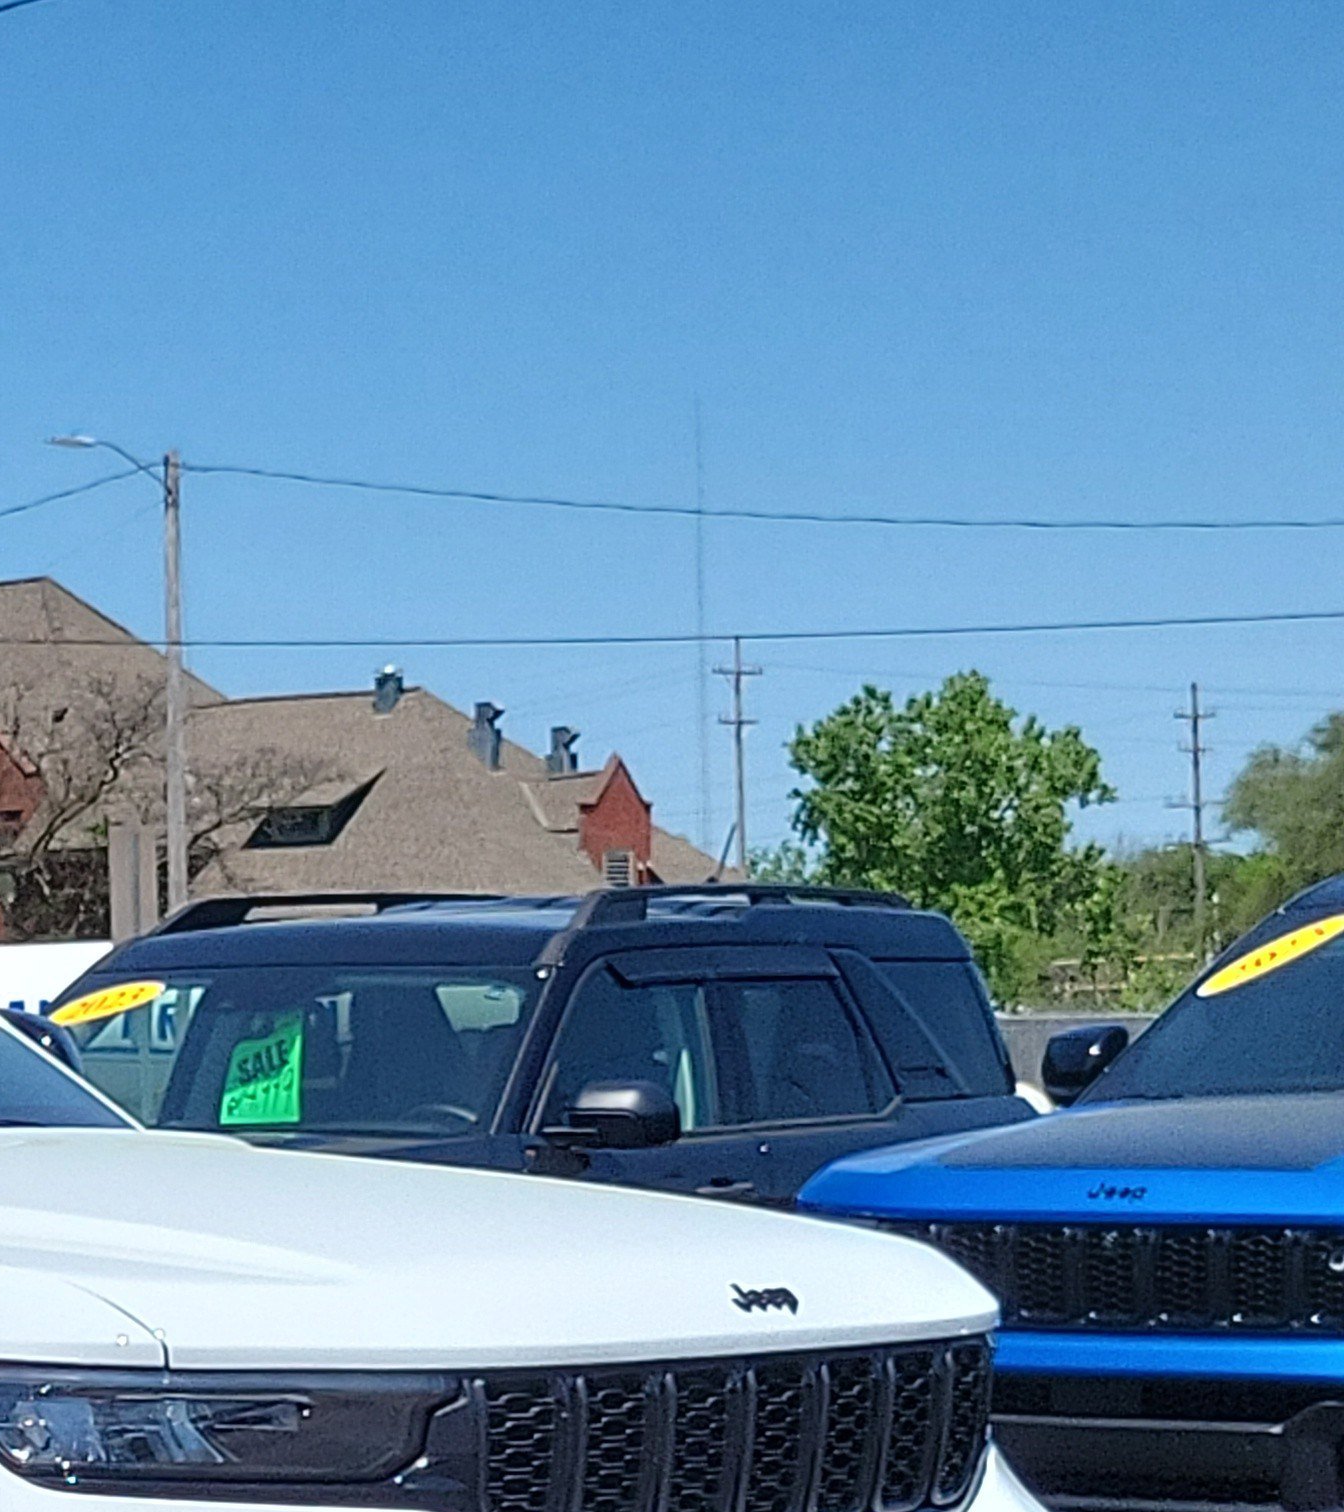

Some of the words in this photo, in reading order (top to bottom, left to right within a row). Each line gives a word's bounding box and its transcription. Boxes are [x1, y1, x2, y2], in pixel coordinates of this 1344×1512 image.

[237, 1038, 290, 1086] SALE
[1086, 1182, 1148, 1204] Jeep
[729, 1283, 799, 1315] Jeep
